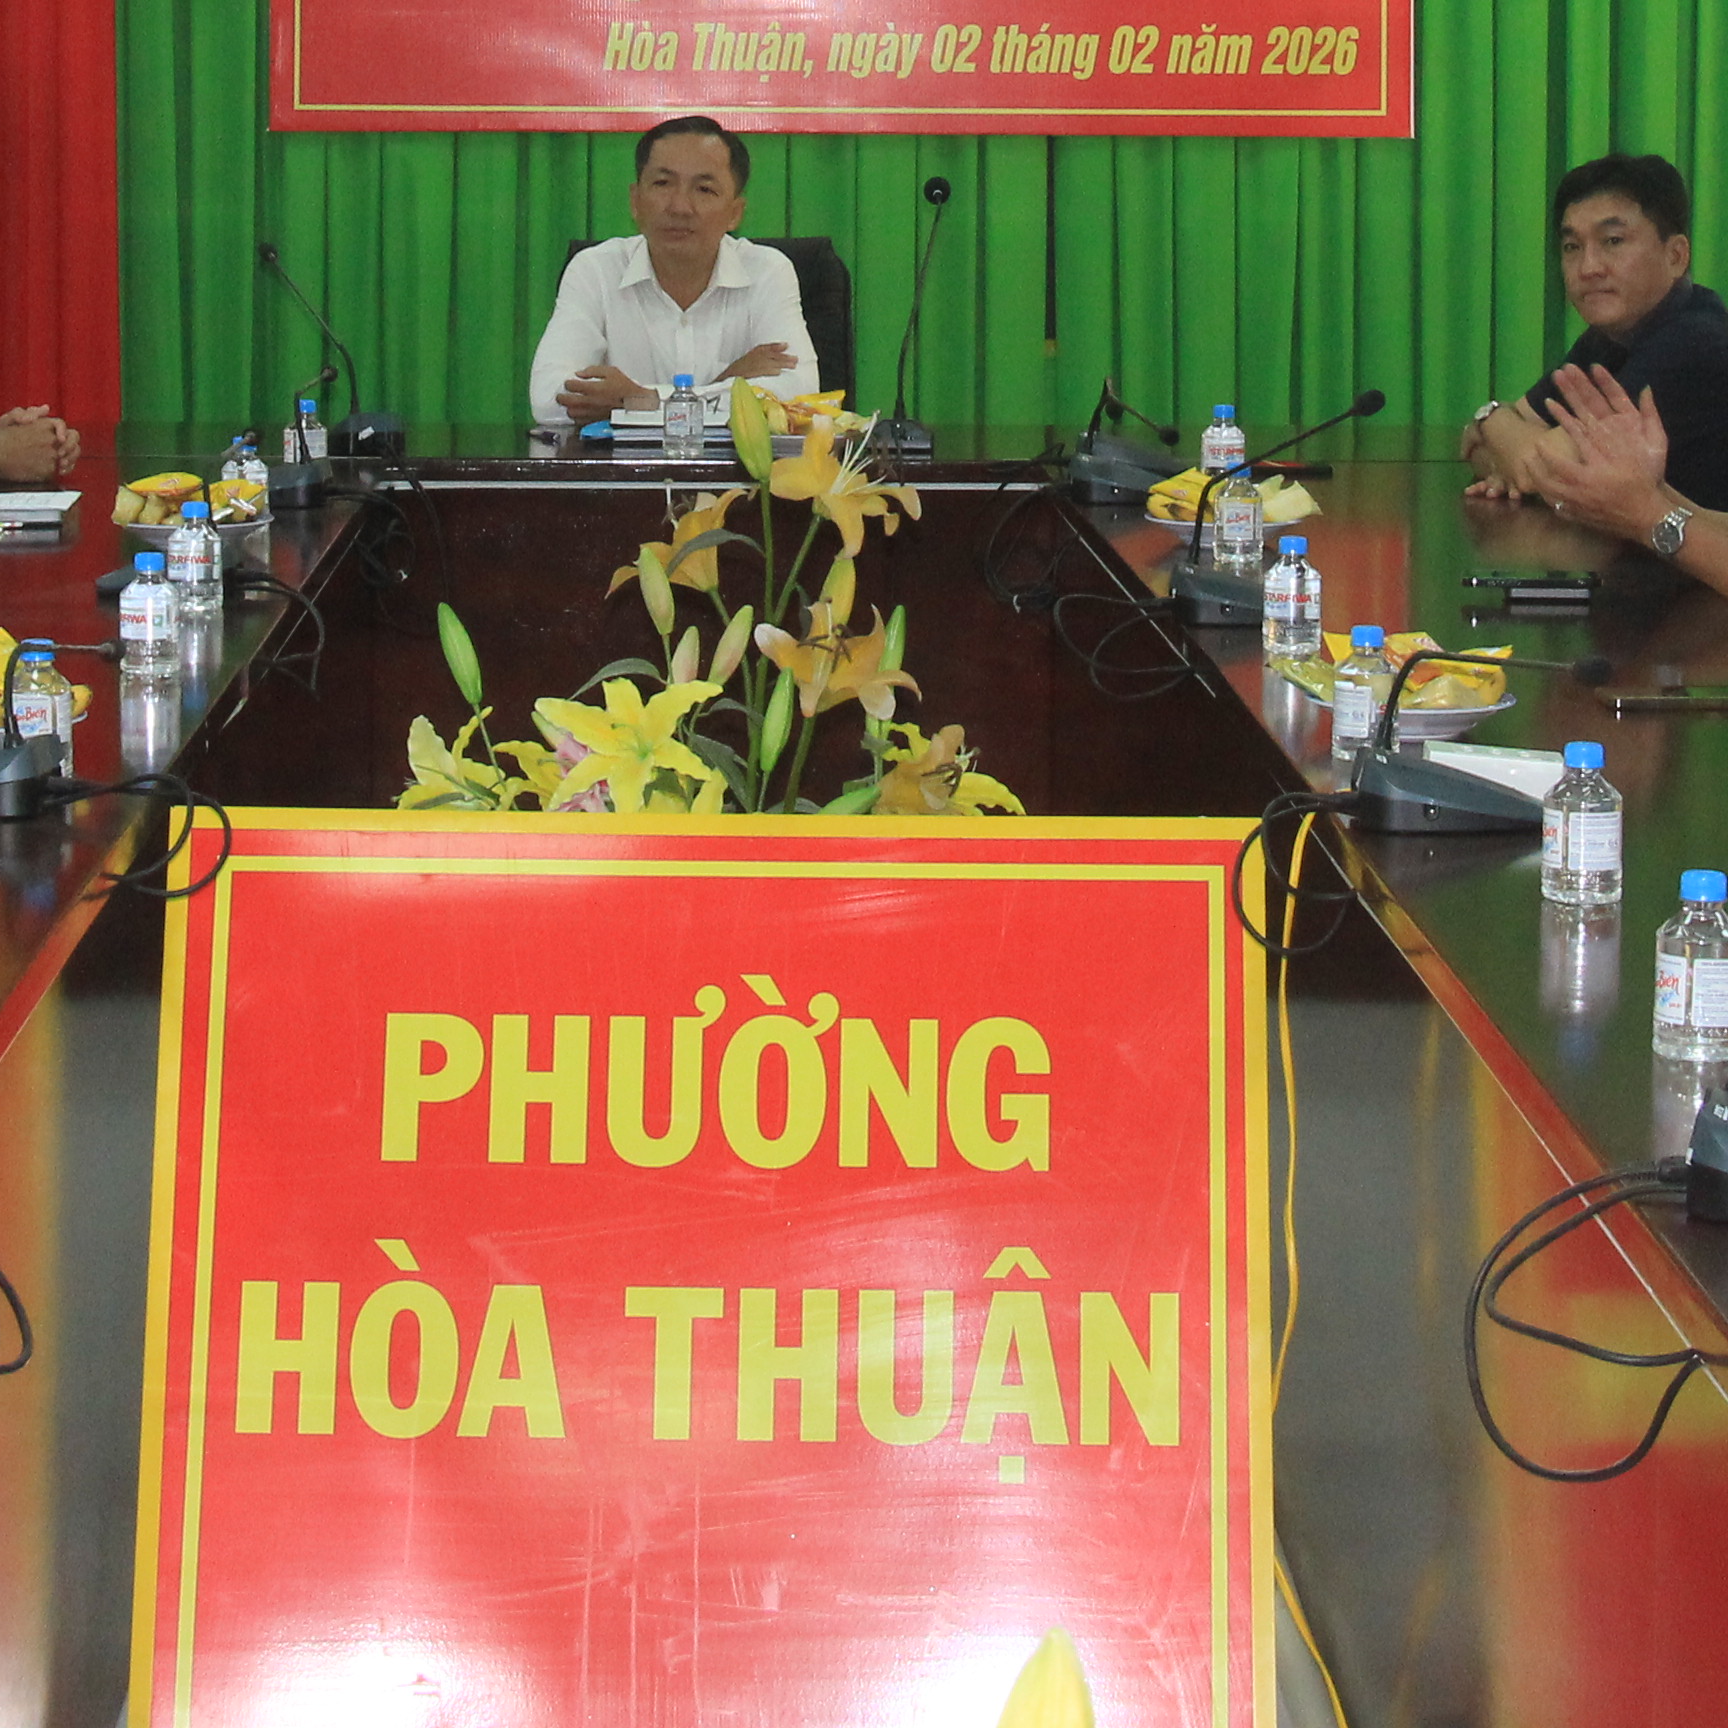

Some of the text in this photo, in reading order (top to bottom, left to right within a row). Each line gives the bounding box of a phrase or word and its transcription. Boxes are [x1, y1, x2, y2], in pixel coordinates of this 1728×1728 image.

[604, 22, 1360, 81] Hòa Thuận, ngày 02 tháng 02 năm 2026
[380, 972, 1052, 1173] PHƯỜNG
[234, 1238, 1182, 1485] HÒA THUẬN
